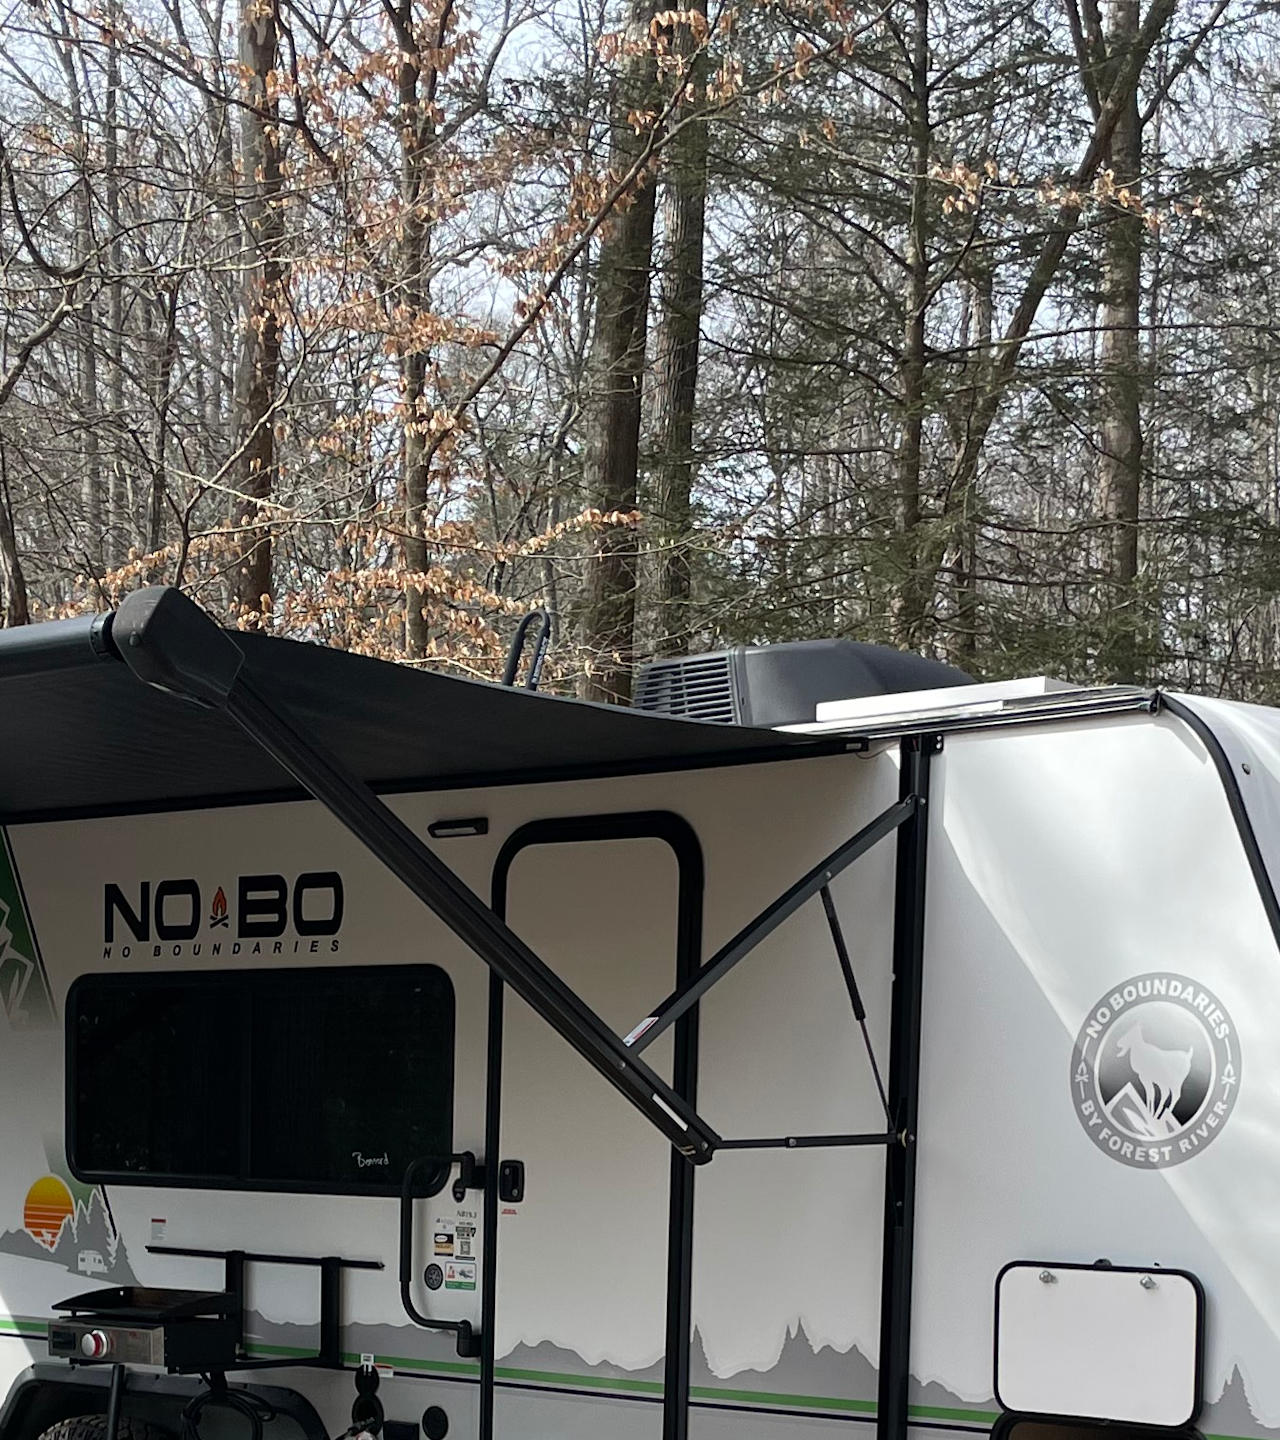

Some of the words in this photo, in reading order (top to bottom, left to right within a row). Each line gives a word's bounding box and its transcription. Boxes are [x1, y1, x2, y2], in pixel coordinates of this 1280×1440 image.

[103, 945, 131, 959] NO
[153, 939, 340, 957] BOUNDARIES
[1085, 1007, 1112, 1039] NO
[1109, 978, 1231, 1040] BOUNDARIES
[1080, 1099, 1103, 1128] BY
[1098, 1128, 1173, 1162] FOREST
[1178, 1101, 1228, 1153] RIVER
